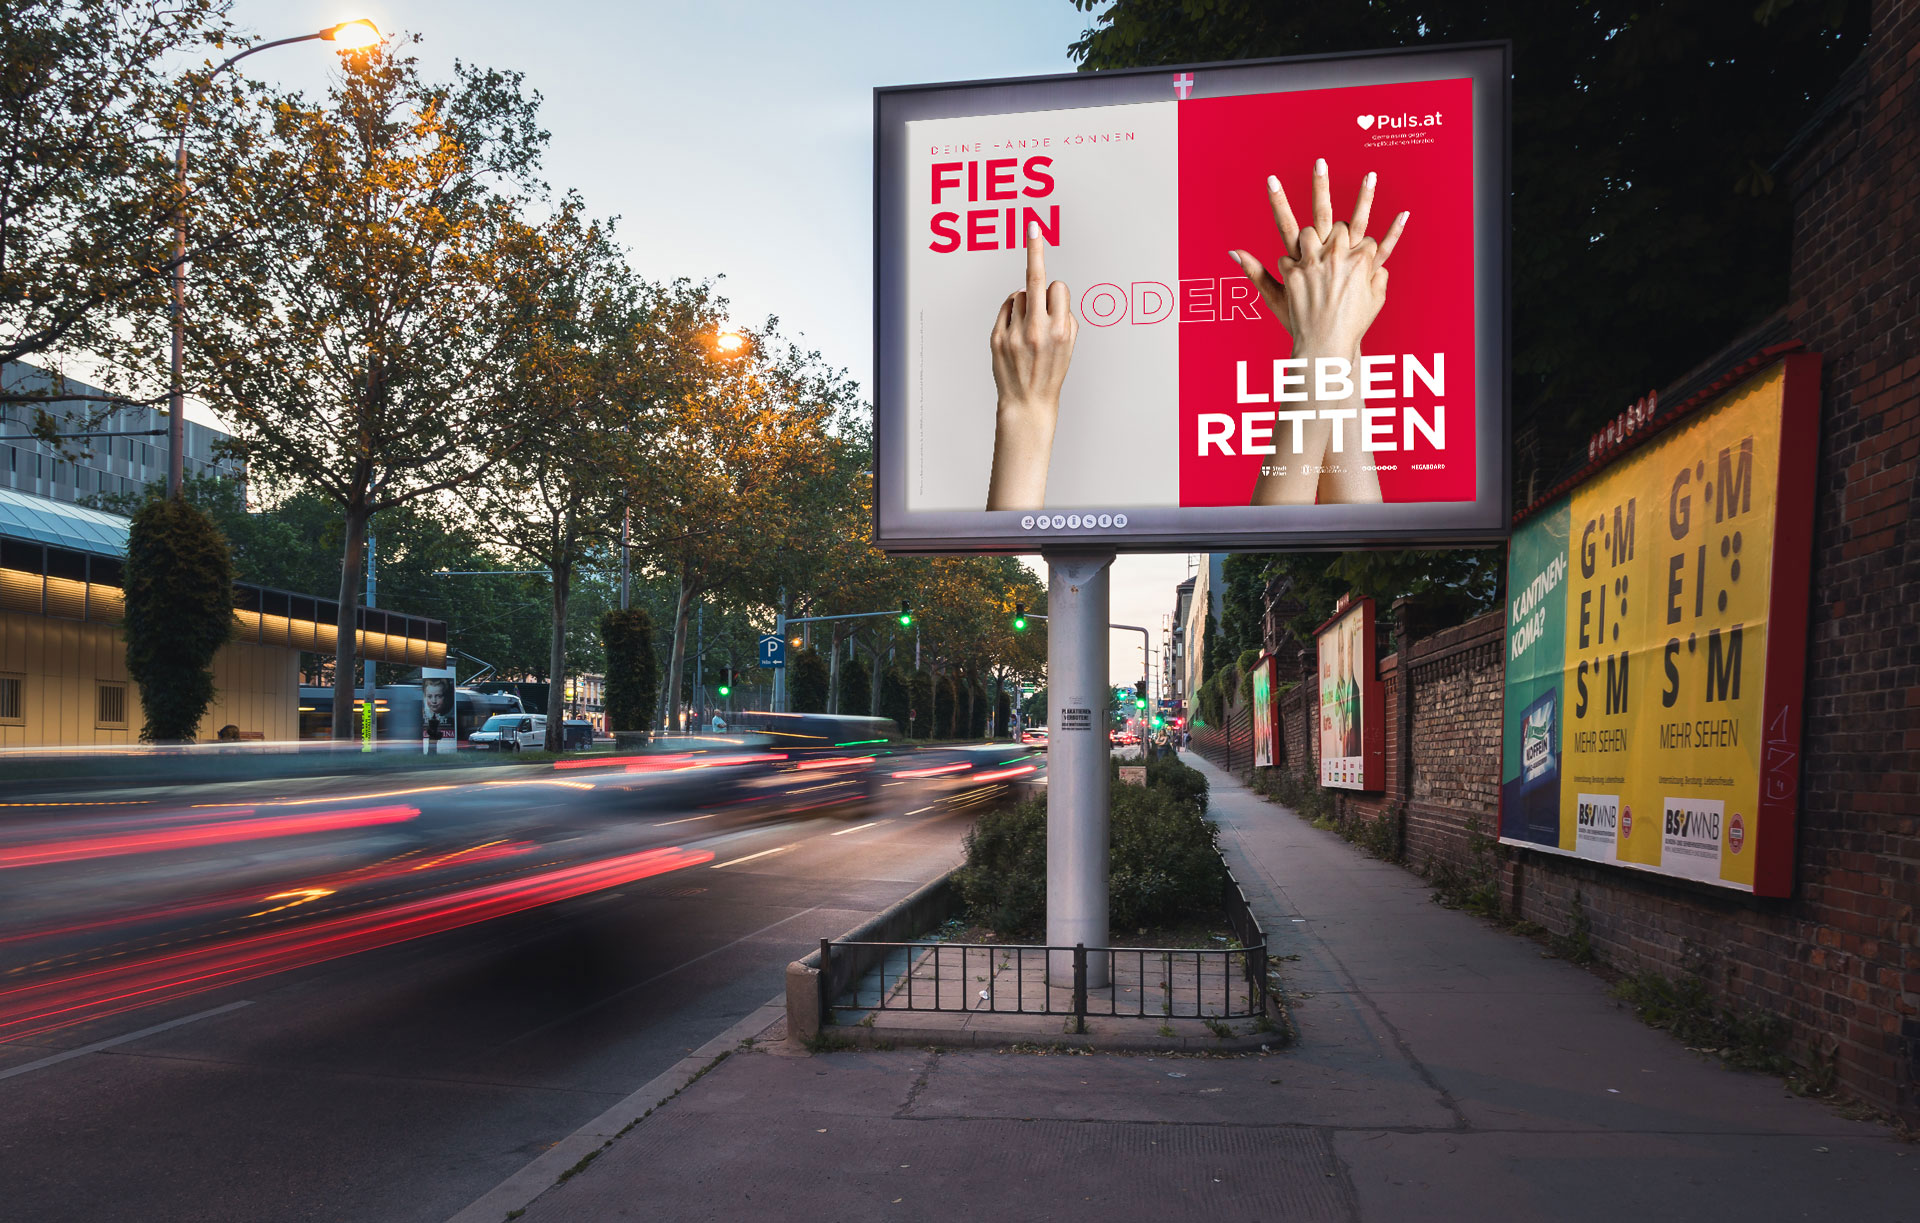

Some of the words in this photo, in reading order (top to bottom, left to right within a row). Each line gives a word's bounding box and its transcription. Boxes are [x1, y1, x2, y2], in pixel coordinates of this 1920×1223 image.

[1377, 111, 1443, 130] Puls.at
[930, 142, 982, 156] DEINE
[931, 155, 1055, 205] FIES
[928, 204, 1060, 254] SEIN
[1080, 276, 1262, 328] ODER
[1236, 352, 1445, 404] LEBEN
[1197, 405, 1446, 457] RETTEN
[1023, 515, 1126, 528] gewista
[1512, 551, 1567, 627] KANTINEN-
[768, 641, 778, 657] P
[1511, 606, 1546, 662] KOMA?
[1574, 730, 1597, 753] MEHR
[1598, 728, 1627, 753] SEHEN
[1659, 722, 1692, 750] MEHR
[1694, 718, 1739, 749] SEHEN
